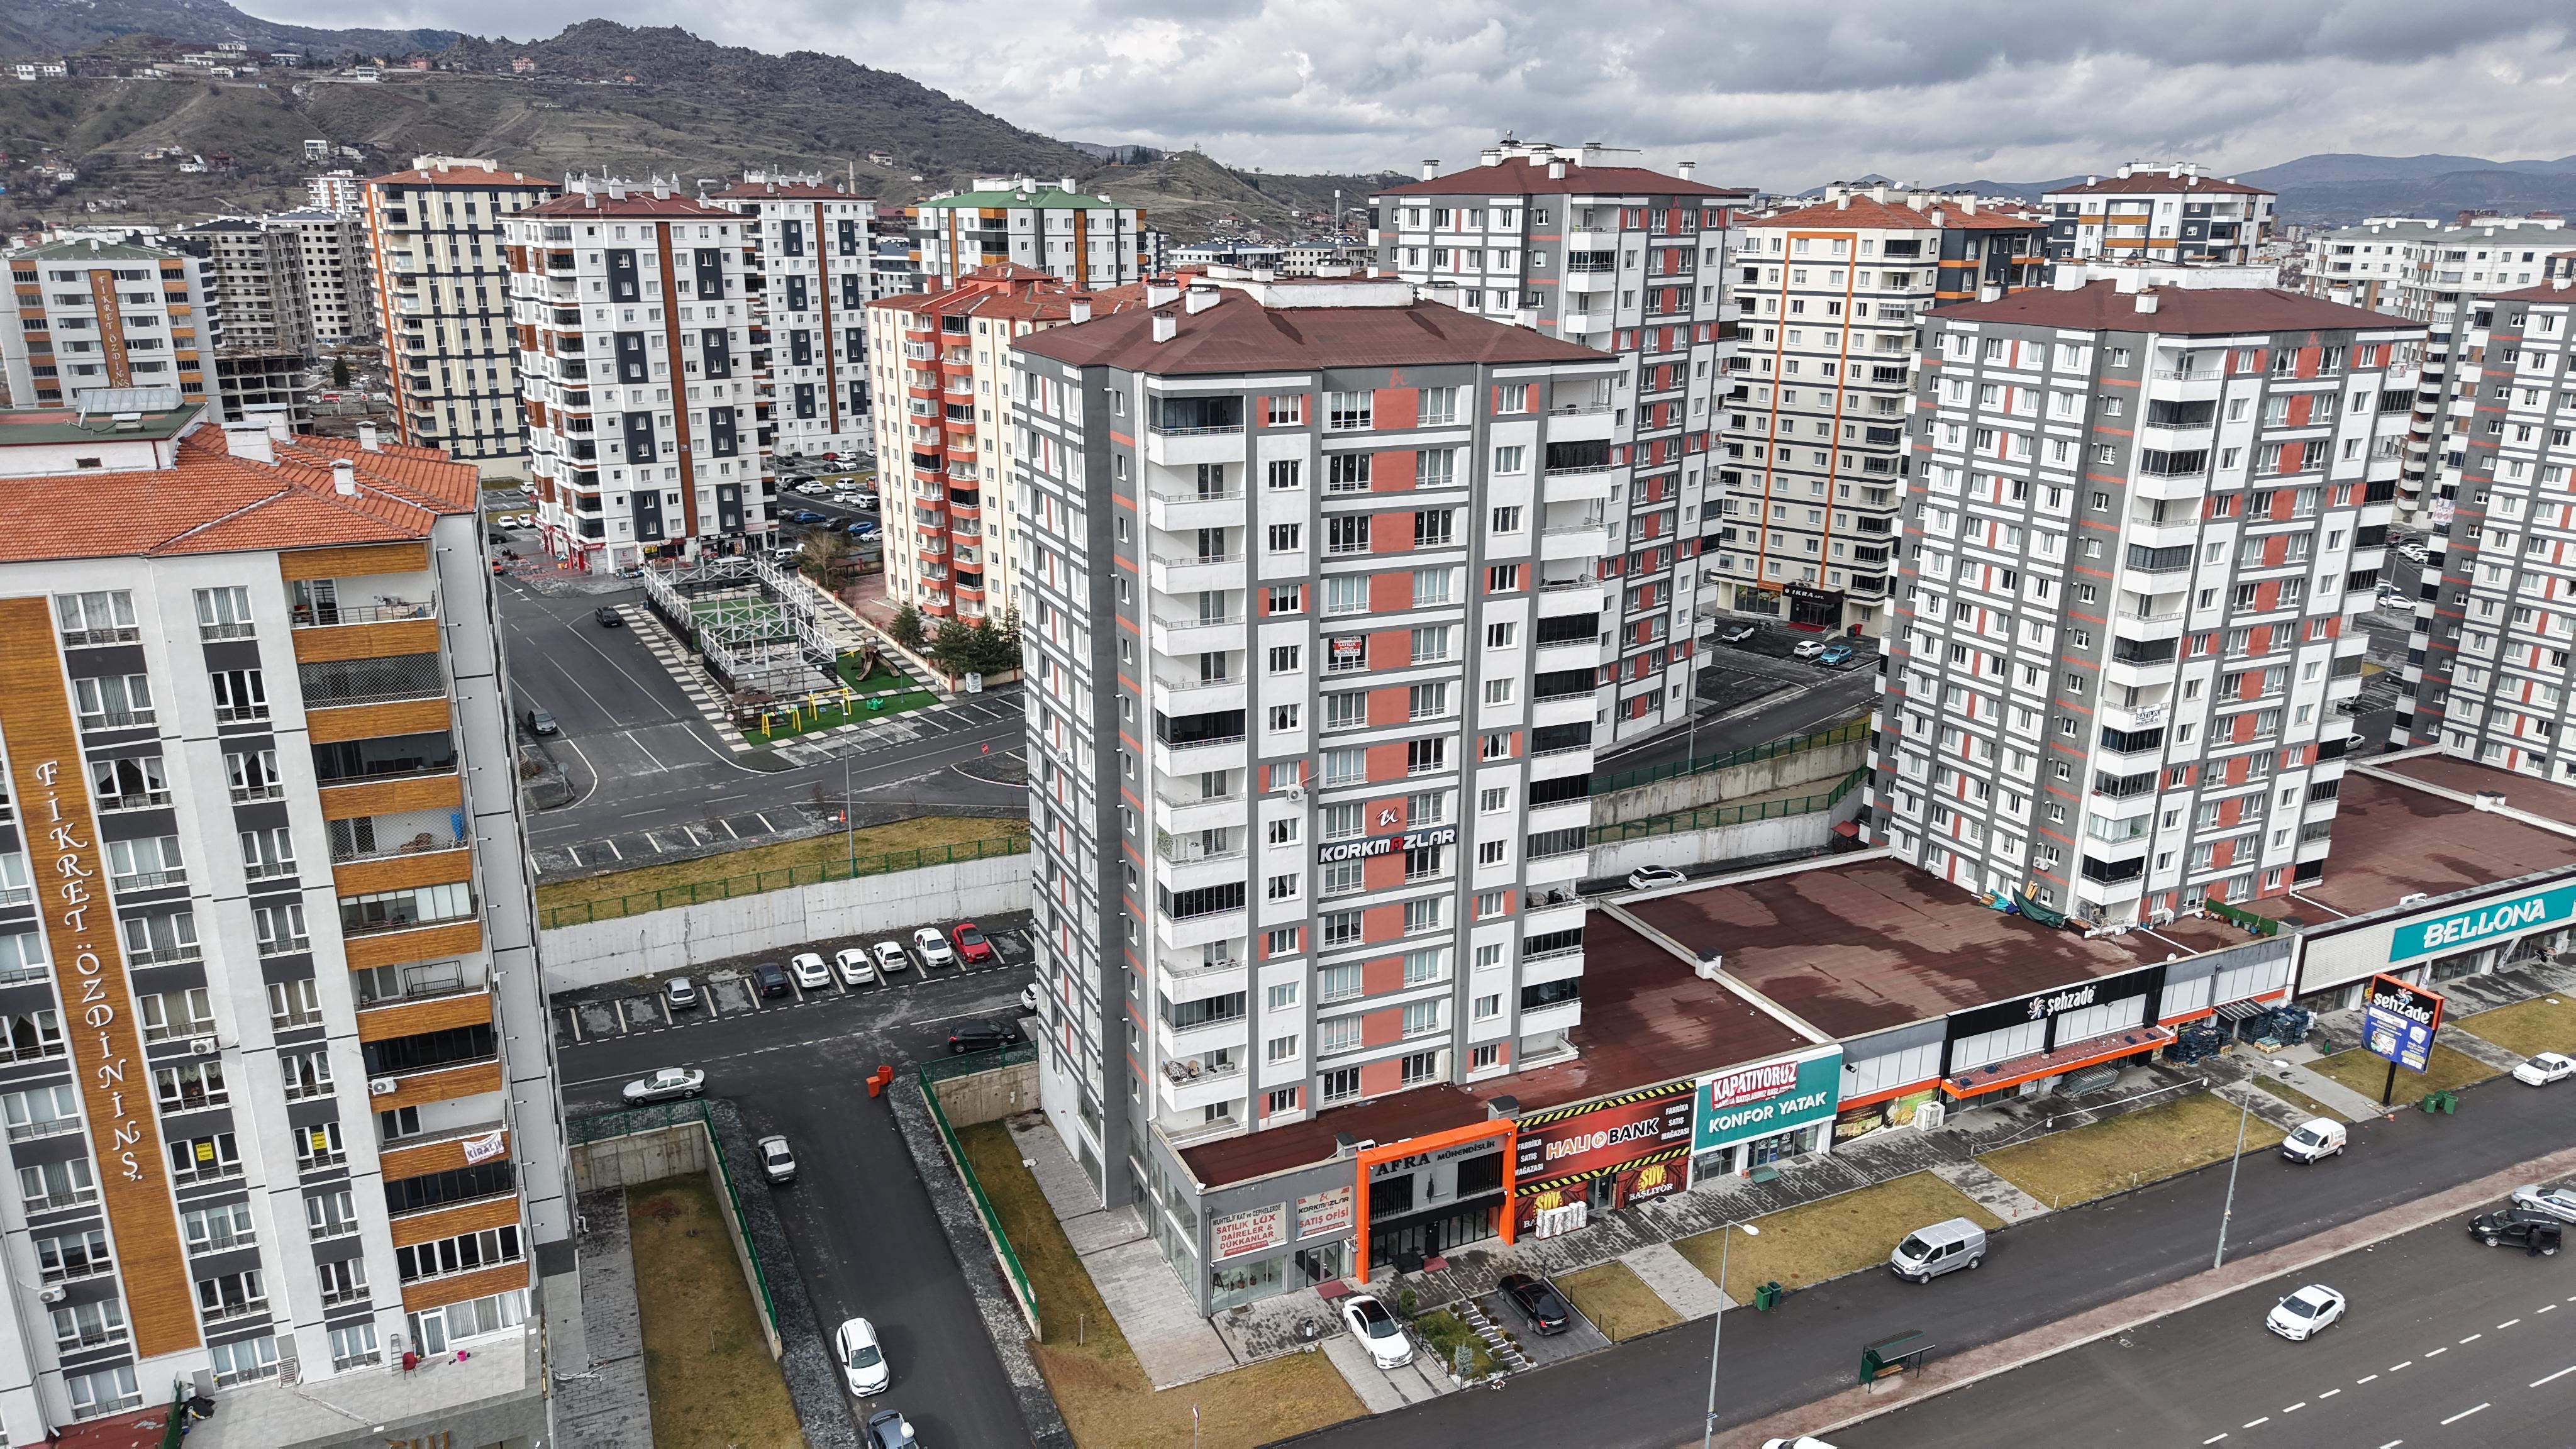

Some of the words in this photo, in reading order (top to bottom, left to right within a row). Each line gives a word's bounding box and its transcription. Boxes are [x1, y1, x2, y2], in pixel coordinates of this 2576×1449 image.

[36, 760, 93, 933] FİKRET
[1320, 829, 1455, 863] KORKMAZLAR
[2424, 899, 2546, 948] BELLONA
[1713, 1062, 1797, 1102] KAPATIYORUZ
[1665, 1104, 1689, 1115] FABRİKA
[1709, 1105, 1774, 1133] KONFOR
[1779, 1092, 1827, 1115] YATAK
[1517, 1139, 1542, 1151] FABRİKA
[1545, 1133, 1591, 1160] HALI
[1607, 1117, 1660, 1145] BANK
[1375, 1153, 1431, 1176] AFRA
[1436, 1140, 1496, 1161] MÜHENDİSLİK
[1629, 1183, 1674, 1201] BAŞLIYOR
[1298, 1196, 1350, 1214] KORKMAZLAR
[1216, 1221, 1248, 1235] SATILIK
[1253, 1214, 1277, 1226] LÜX
[1236, 1211, 1246, 1221] KAT
[1299, 1215, 1323, 1228] SATIŞ
[1325, 1206, 1349, 1221] OFİSİ
[1220, 1231, 1274, 1250] DÜKKANLAR
[1221, 1226, 1263, 1241] DAİRELER
